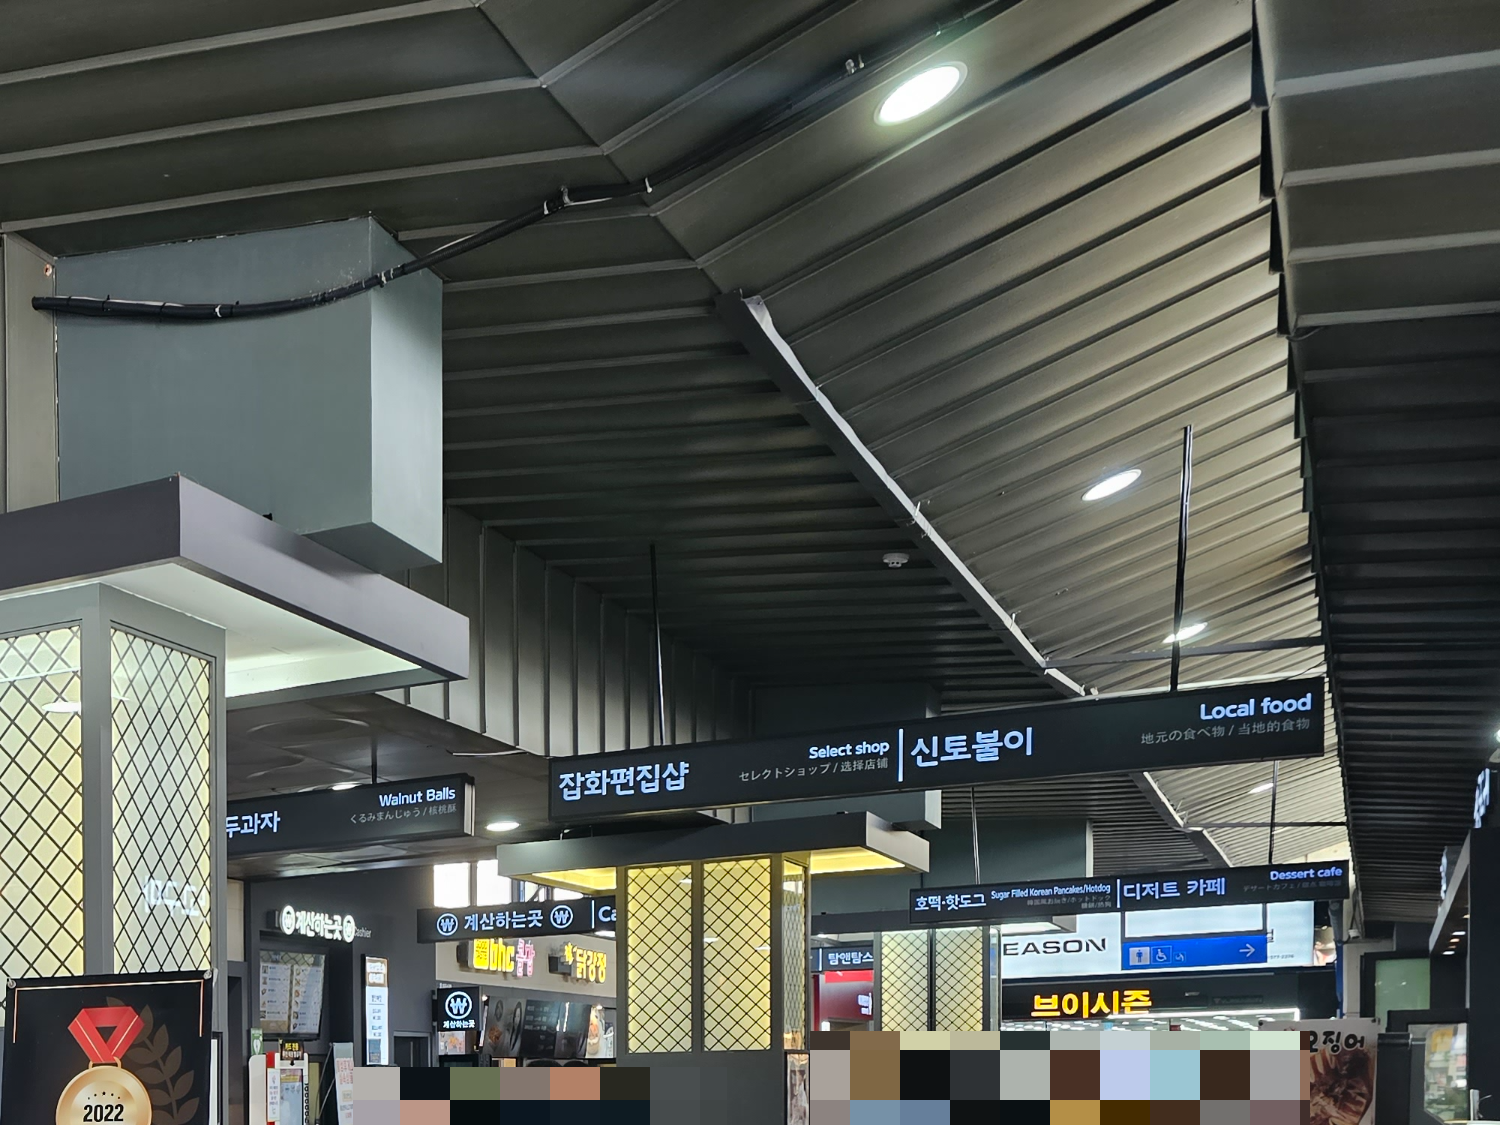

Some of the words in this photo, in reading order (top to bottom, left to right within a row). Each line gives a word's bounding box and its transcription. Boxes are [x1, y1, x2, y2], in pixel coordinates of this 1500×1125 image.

[1200, 699, 1255, 721] Local
[1261, 693, 1313, 715] food
[808, 743, 852, 760] Select
[855, 740, 890, 757] shop
[910, 726, 1033, 768] 신토불이
[558, 761, 690, 801] 잡화편집샵
[379, 790, 423, 808] Walnut
[426, 787, 456, 802] Balls
[1270, 868, 1315, 881] Dessert
[1317, 866, 1343, 878] cafe
[991, 890, 1010, 900] Sugar
[1011, 888, 1029, 898] Filled
[1029, 888, 1053, 897] Korean
[1123, 881, 1181, 900] 디저트
[1186, 877, 1226, 897] 카페
[295, 910, 343, 940] 계산하는곳
[464, 909, 544, 931] 계산하는곳
[490, 937, 515, 973] bhc
[1003, 937, 1106, 956] EASON
[576, 948, 607, 984] 닭강정
[828, 951, 874, 965] 탐앤탐스
[1031, 989, 1152, 1019] 브이시즌
[442, 1019, 475, 1029] 계산하는곳
[83, 1103, 124, 1123] 2022
